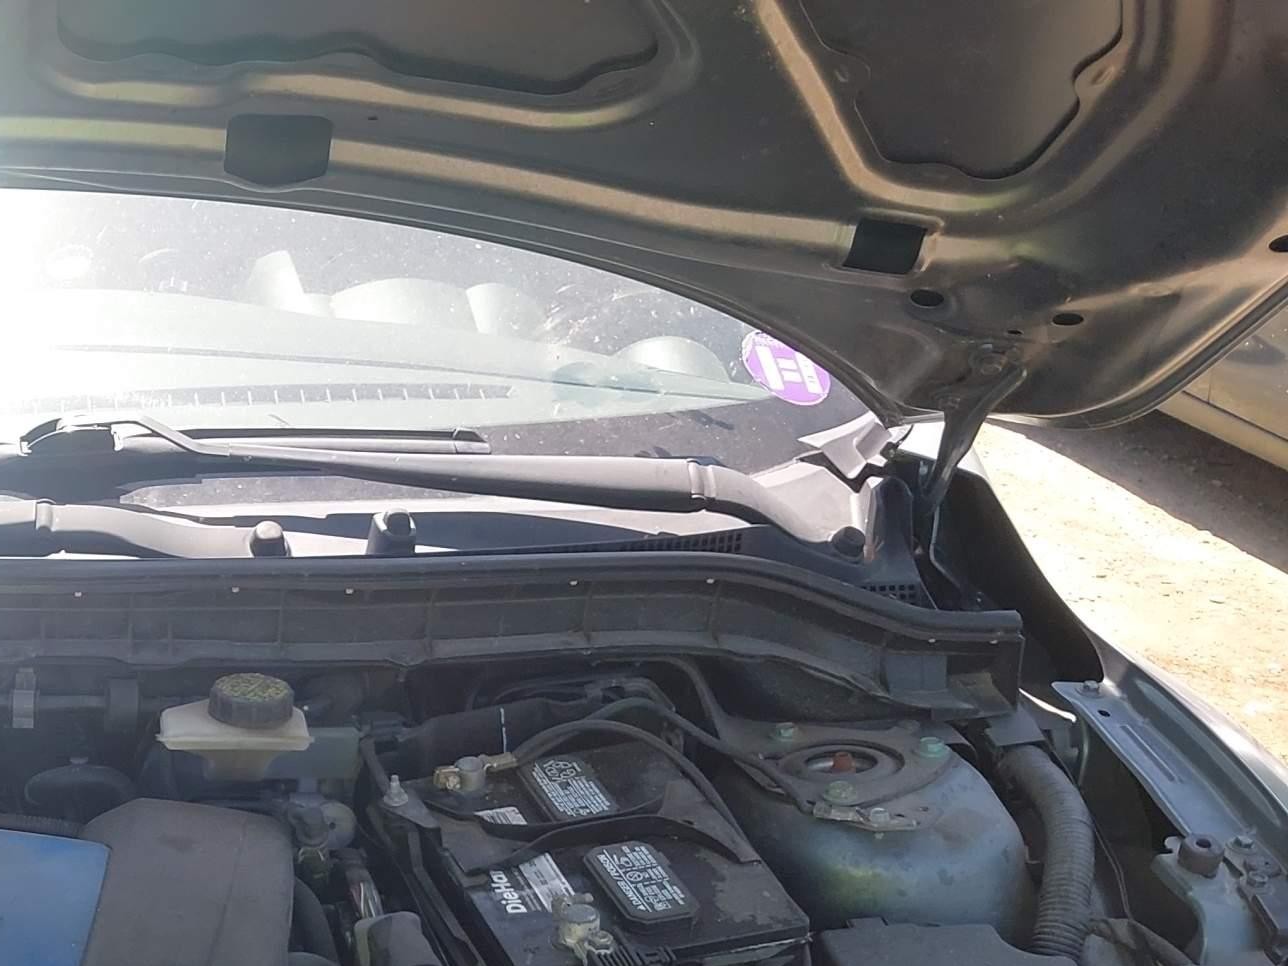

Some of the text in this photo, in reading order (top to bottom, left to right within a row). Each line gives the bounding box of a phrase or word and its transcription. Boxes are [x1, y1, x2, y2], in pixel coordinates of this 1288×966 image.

[596, 854, 617, 876] POISON
[489, 870, 527, 914] DieHar
[616, 880, 641, 905] DANGER
